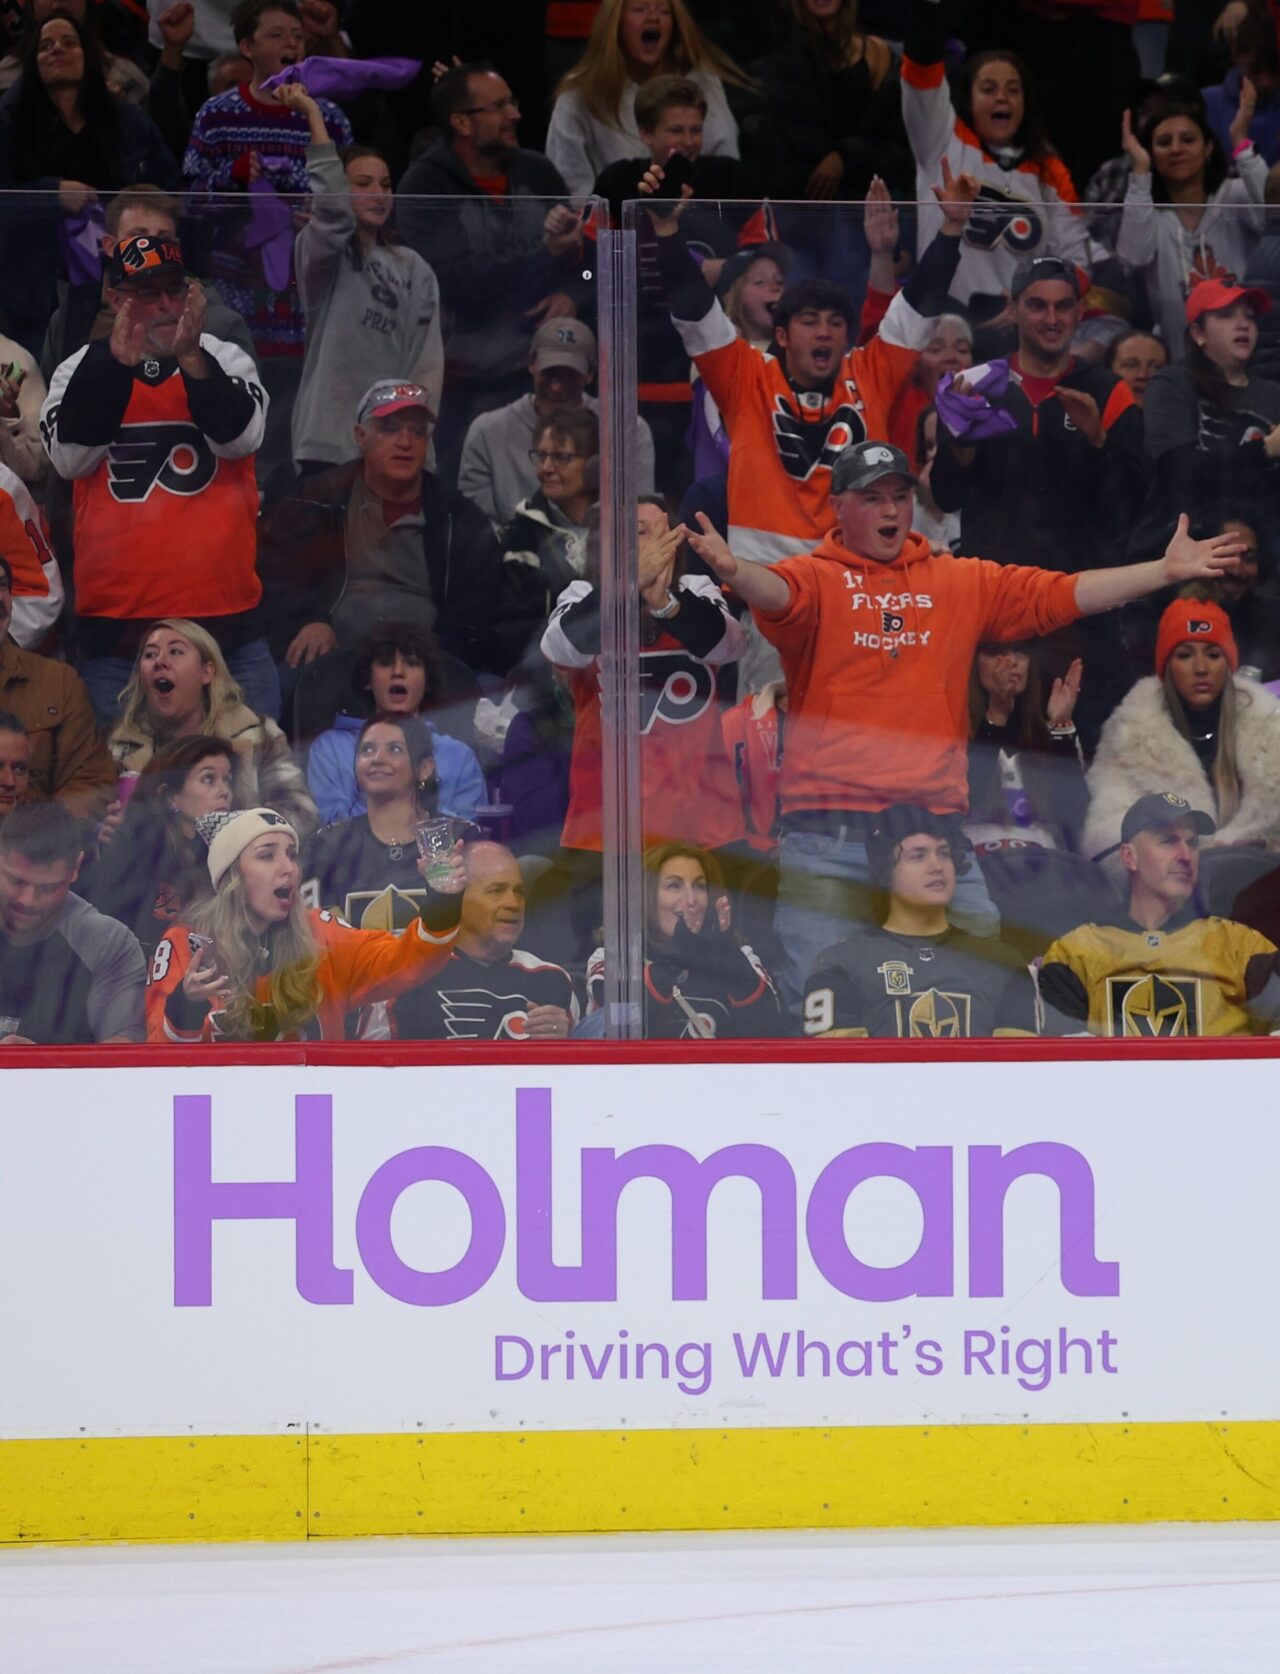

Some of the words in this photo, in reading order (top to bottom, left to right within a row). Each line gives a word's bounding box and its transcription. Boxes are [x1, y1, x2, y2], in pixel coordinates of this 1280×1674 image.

[852, 593, 933, 611] FLYERS
[853, 630, 931, 650] HOCKEY
[173, 1088, 1121, 1308] Holman
[496, 1330, 714, 1395] Driving
[733, 1325, 943, 1378] What's
[964, 1327, 1118, 1391] Right
